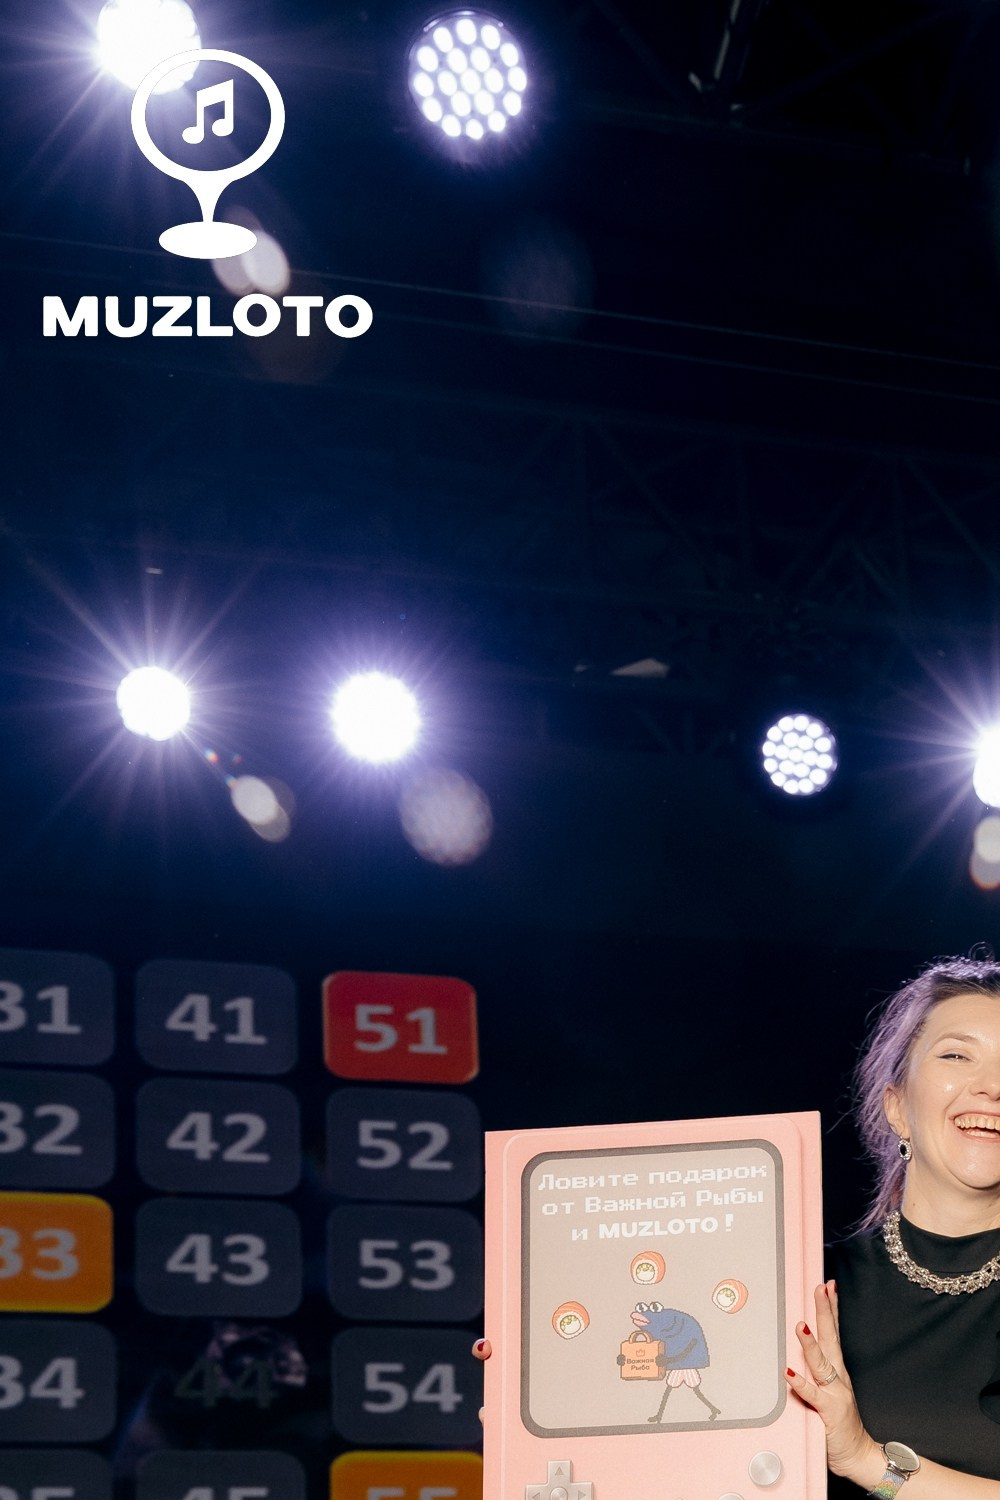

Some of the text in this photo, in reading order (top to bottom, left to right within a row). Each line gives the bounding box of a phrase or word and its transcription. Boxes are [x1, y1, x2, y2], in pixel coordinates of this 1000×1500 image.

[165, 994, 267, 1045] 41
[354, 1004, 448, 1055] 51
[166, 1112, 270, 1163] 42
[357, 1120, 454, 1170] 52
[538, 1164, 768, 1191] Ловите подарок
[541, 1187, 764, 1216] от Важной Рыбы
[571, 1228, 589, 1241] и
[165, 1234, 271, 1286] 43
[358, 1240, 456, 1291] 53
[362, 1363, 463, 1413] 54
